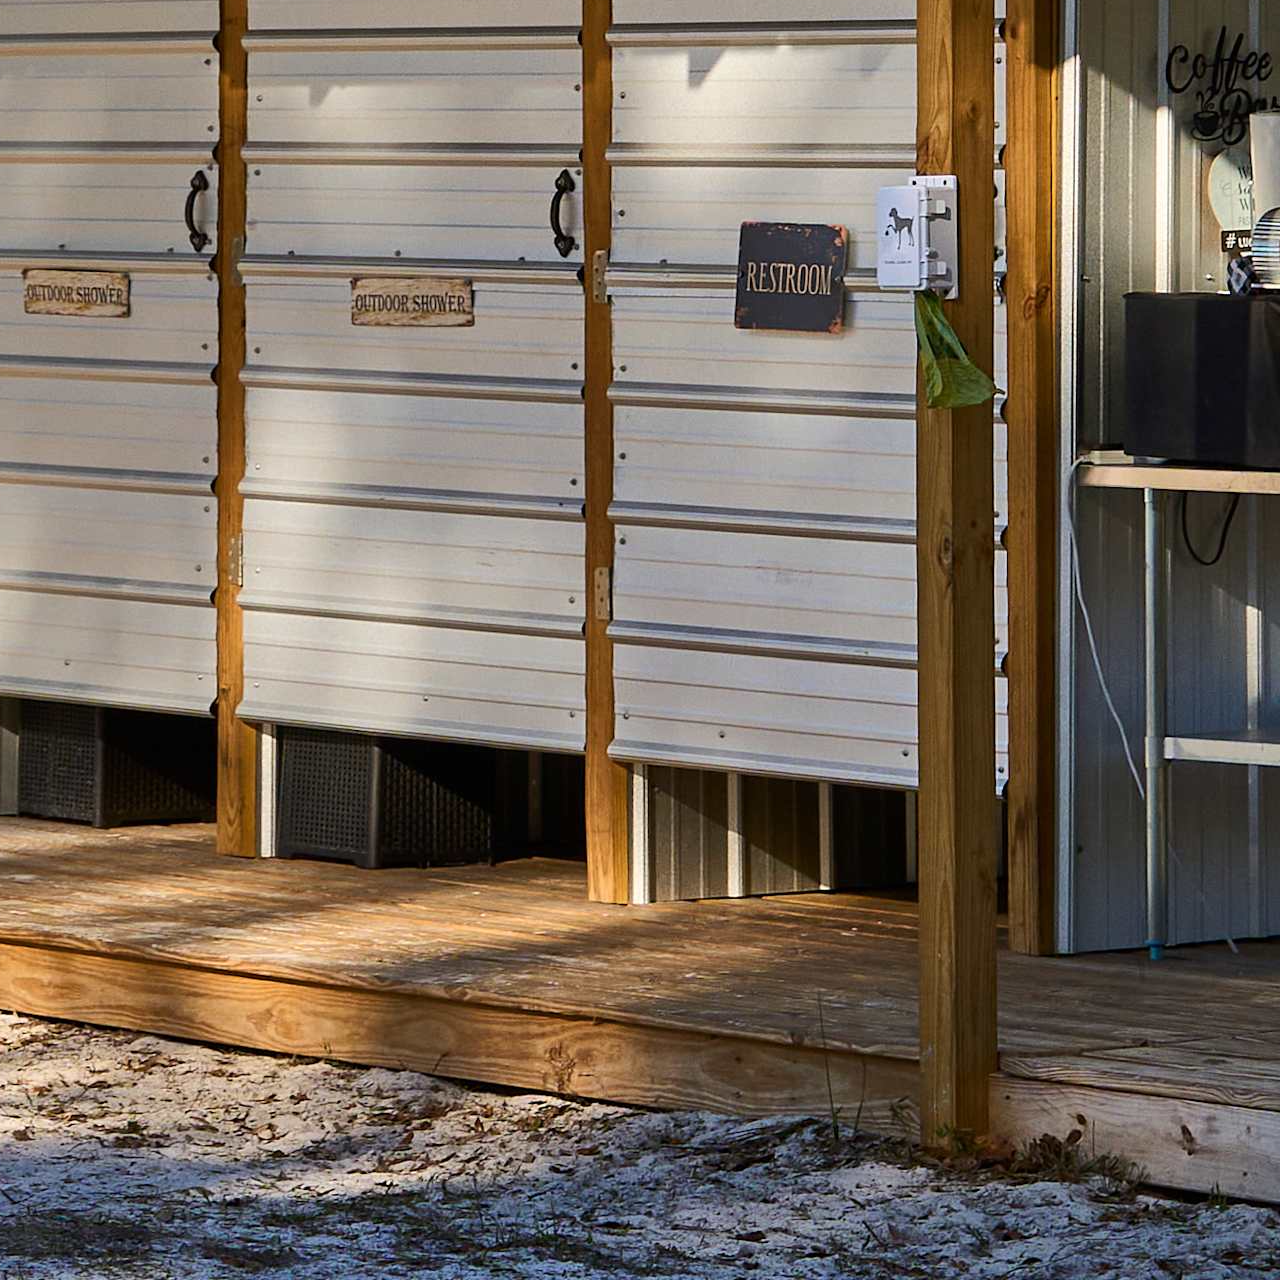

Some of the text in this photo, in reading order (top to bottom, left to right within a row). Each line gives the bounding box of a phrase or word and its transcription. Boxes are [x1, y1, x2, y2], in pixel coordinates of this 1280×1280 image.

[1166, 25, 1273, 95] Coffee
[746, 261, 833, 296] RESTROOM
[26, 284, 124, 305] OUTDOOR SHOWER
[355, 292, 466, 313] OUTDOOR SHOWER
